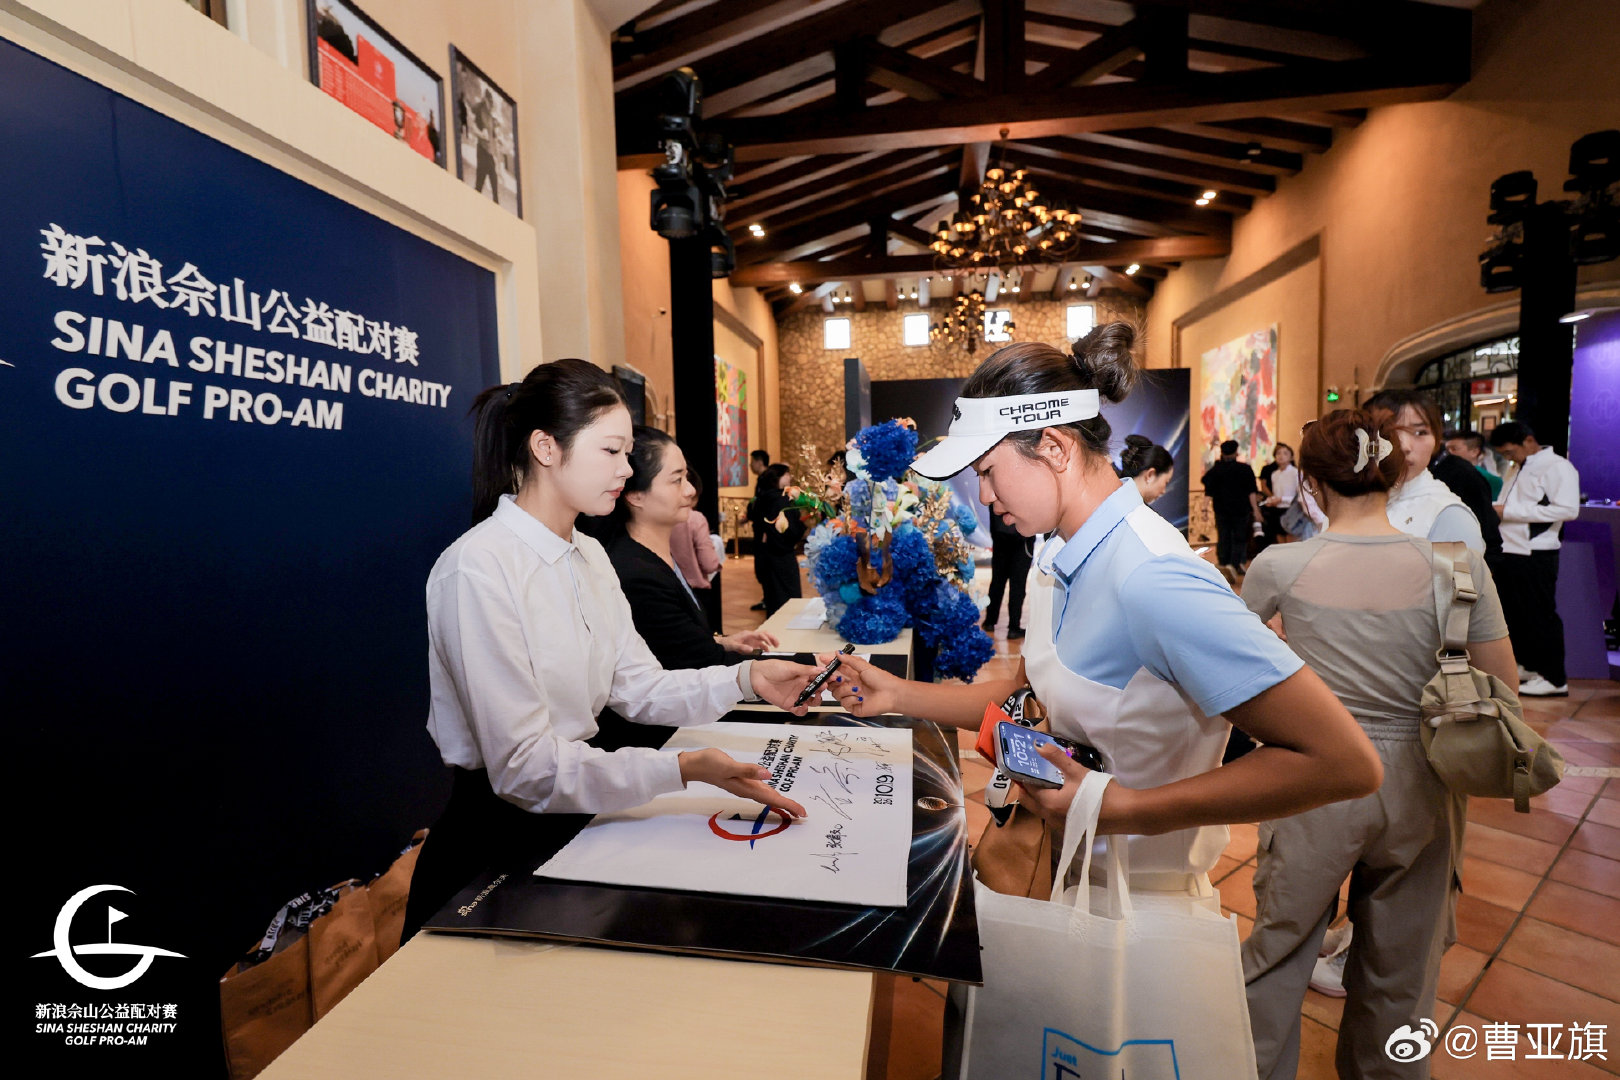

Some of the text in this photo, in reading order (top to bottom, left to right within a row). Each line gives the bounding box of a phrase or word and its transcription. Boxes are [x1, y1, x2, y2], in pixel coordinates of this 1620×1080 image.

[39, 222, 420, 367] 新浪佘山公益配对赛
[51, 310, 452, 408] SINA SHESHAN CHARITY
[54, 367, 344, 430] GOLF PRO-AM
[1000, 398, 1070, 416] CHROME
[1011, 409, 1062, 425] TOUR
[1014, 733, 1030, 766] 10:21
[1051, 1046, 1078, 1067] Just
